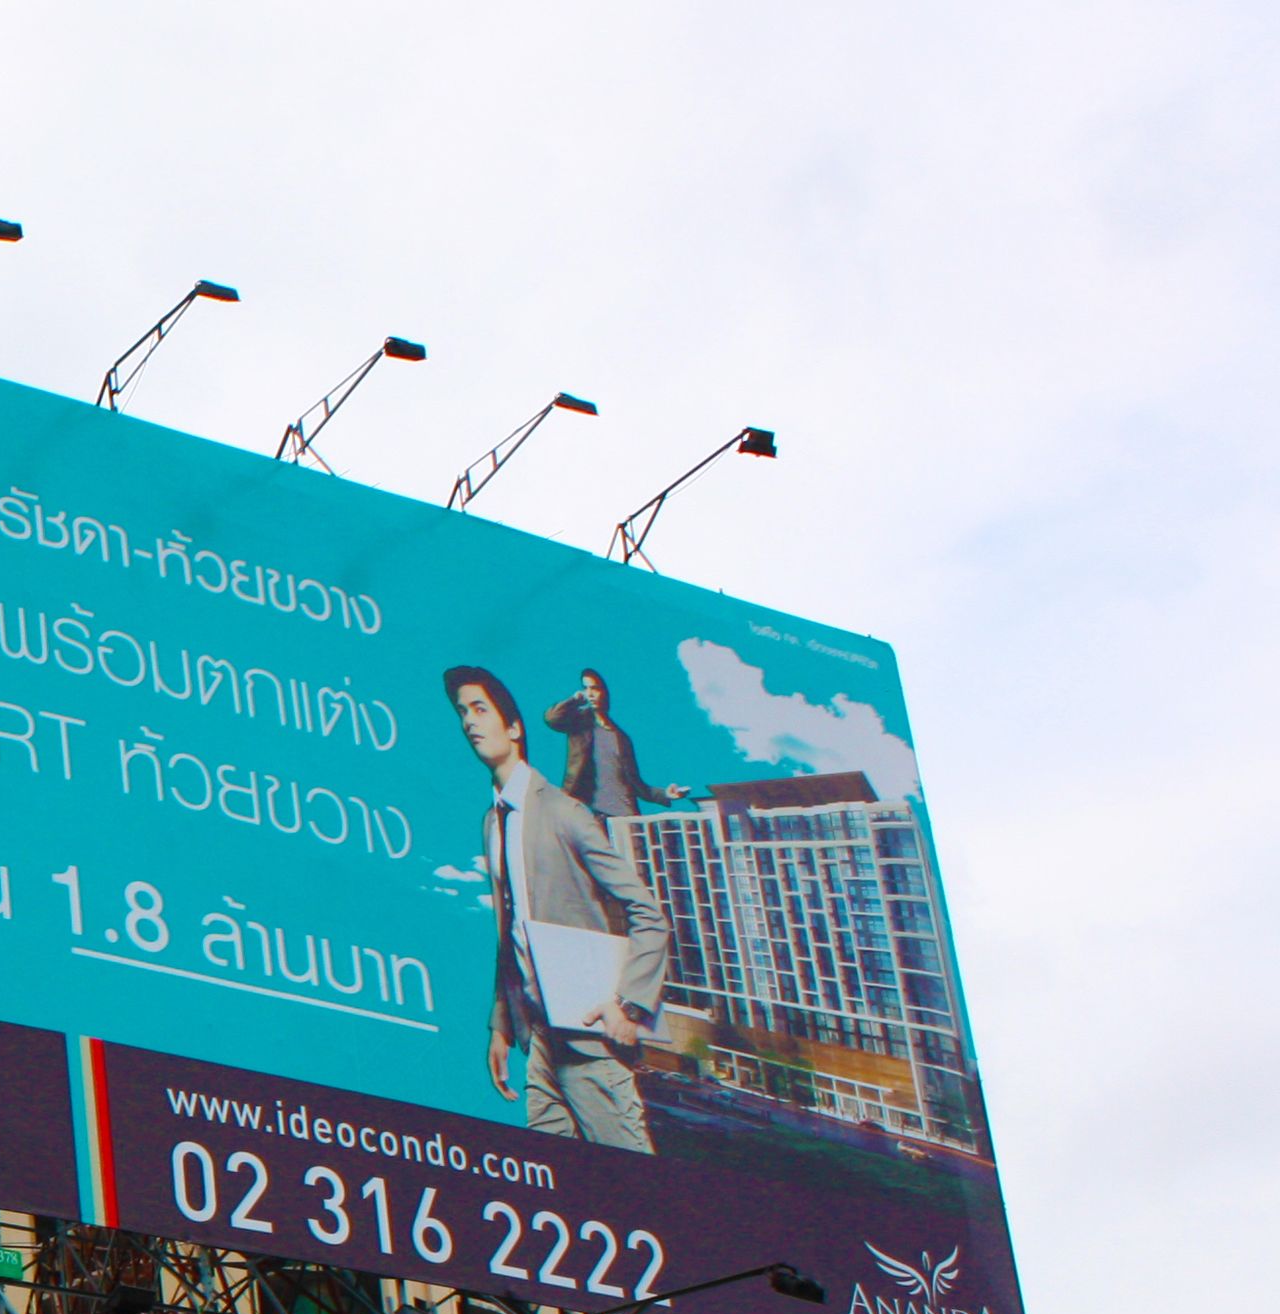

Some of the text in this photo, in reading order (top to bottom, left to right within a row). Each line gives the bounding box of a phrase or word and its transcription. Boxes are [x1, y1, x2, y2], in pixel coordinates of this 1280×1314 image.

[119, 726, 413, 860] ห้วยขวาง
[50, 865, 170, 953] 1.8
[202, 896, 436, 1014] ล้านบาท
[165, 1086, 556, 1191] www.ideocondo.com
[172, 1140, 672, 1307] 02 316 2222
